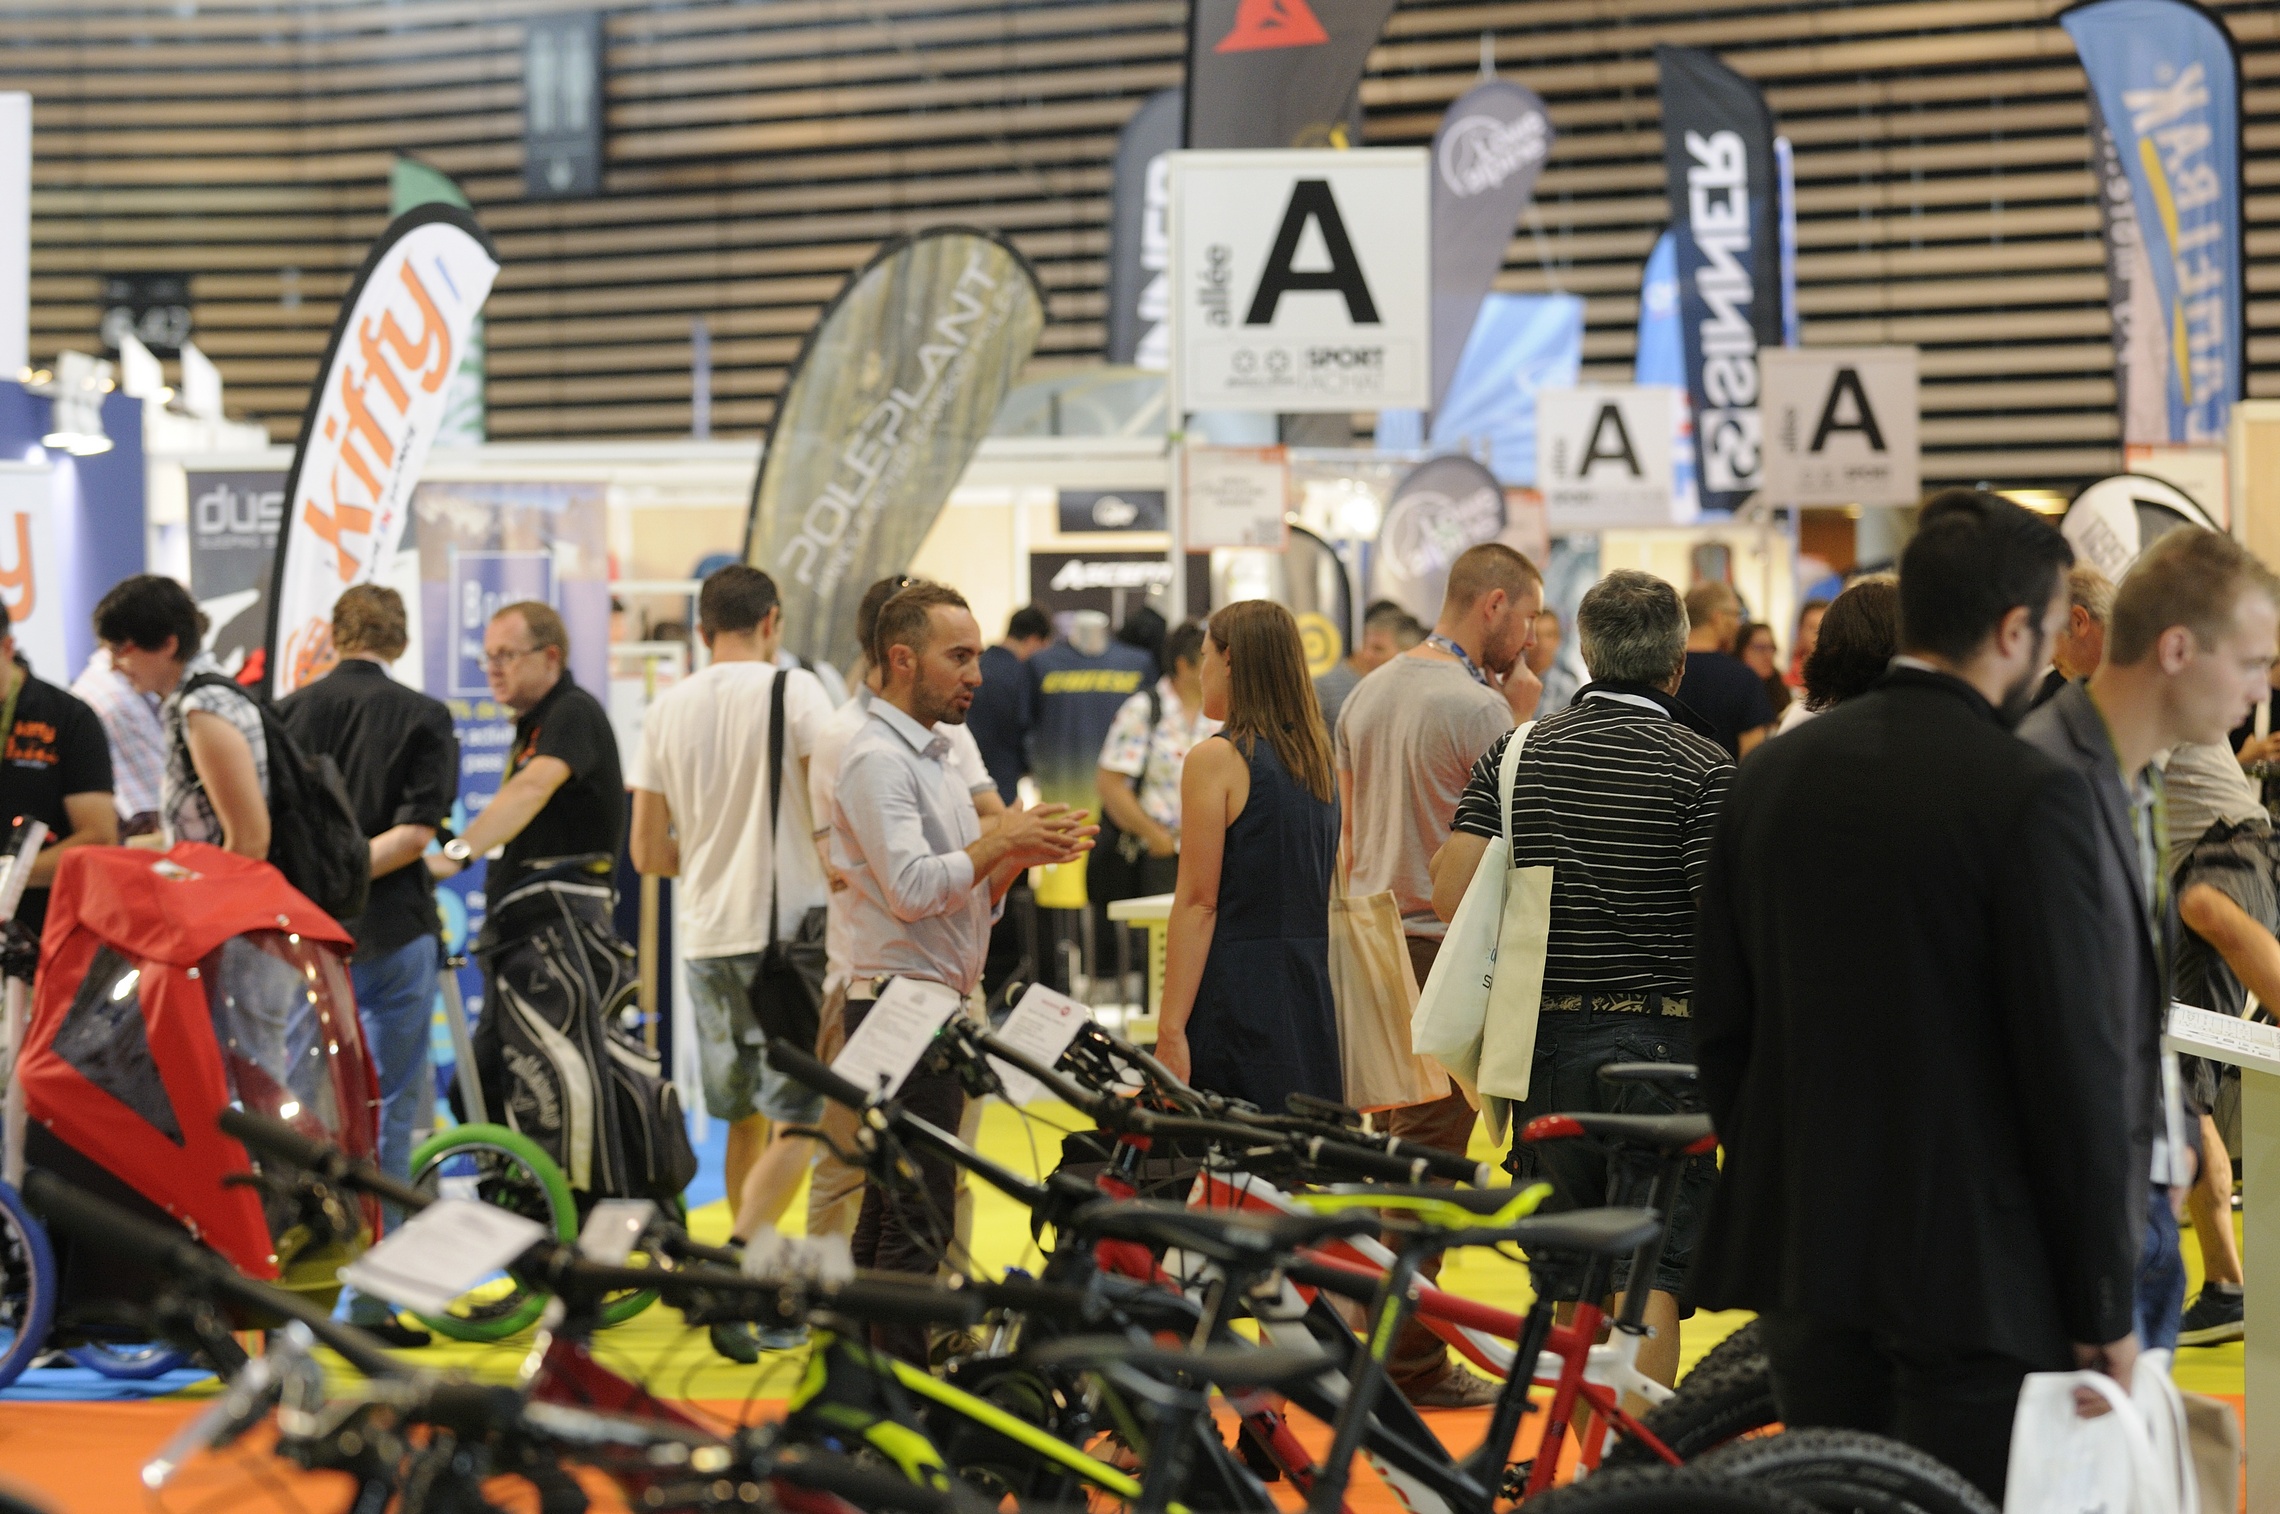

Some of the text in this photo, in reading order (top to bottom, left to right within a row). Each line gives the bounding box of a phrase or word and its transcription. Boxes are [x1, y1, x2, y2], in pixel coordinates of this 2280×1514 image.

[1243, 178, 1384, 326] A
[1307, 347, 1384, 368] SPORT
[1809, 367, 1888, 453] A
[303, 257, 451, 583] kiffy
[778, 253, 995, 584] POLEPLANT
[1578, 403, 1642, 478] A
